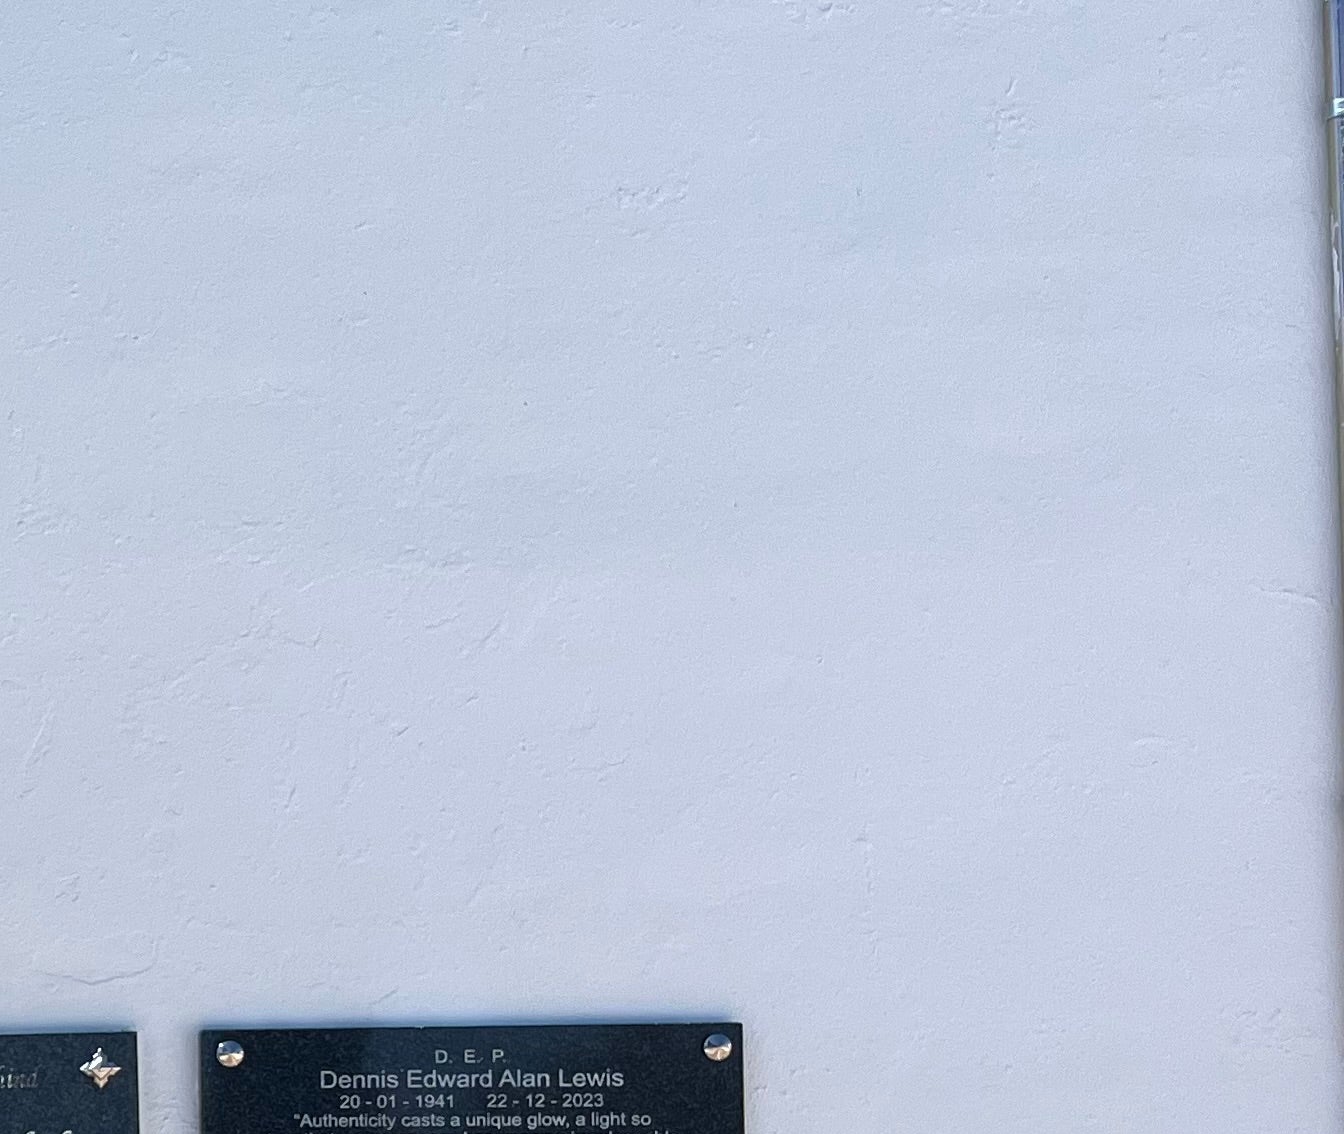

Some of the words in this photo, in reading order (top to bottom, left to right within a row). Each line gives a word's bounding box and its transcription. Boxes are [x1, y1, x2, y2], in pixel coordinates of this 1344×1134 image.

[435, 1050, 452, 1063] D.
[321, 1070, 399, 1089] Dennis
[407, 1069, 492, 1088] Edward
[499, 1069, 550, 1087] Alan
[559, 1069, 624, 1087] Lewis
